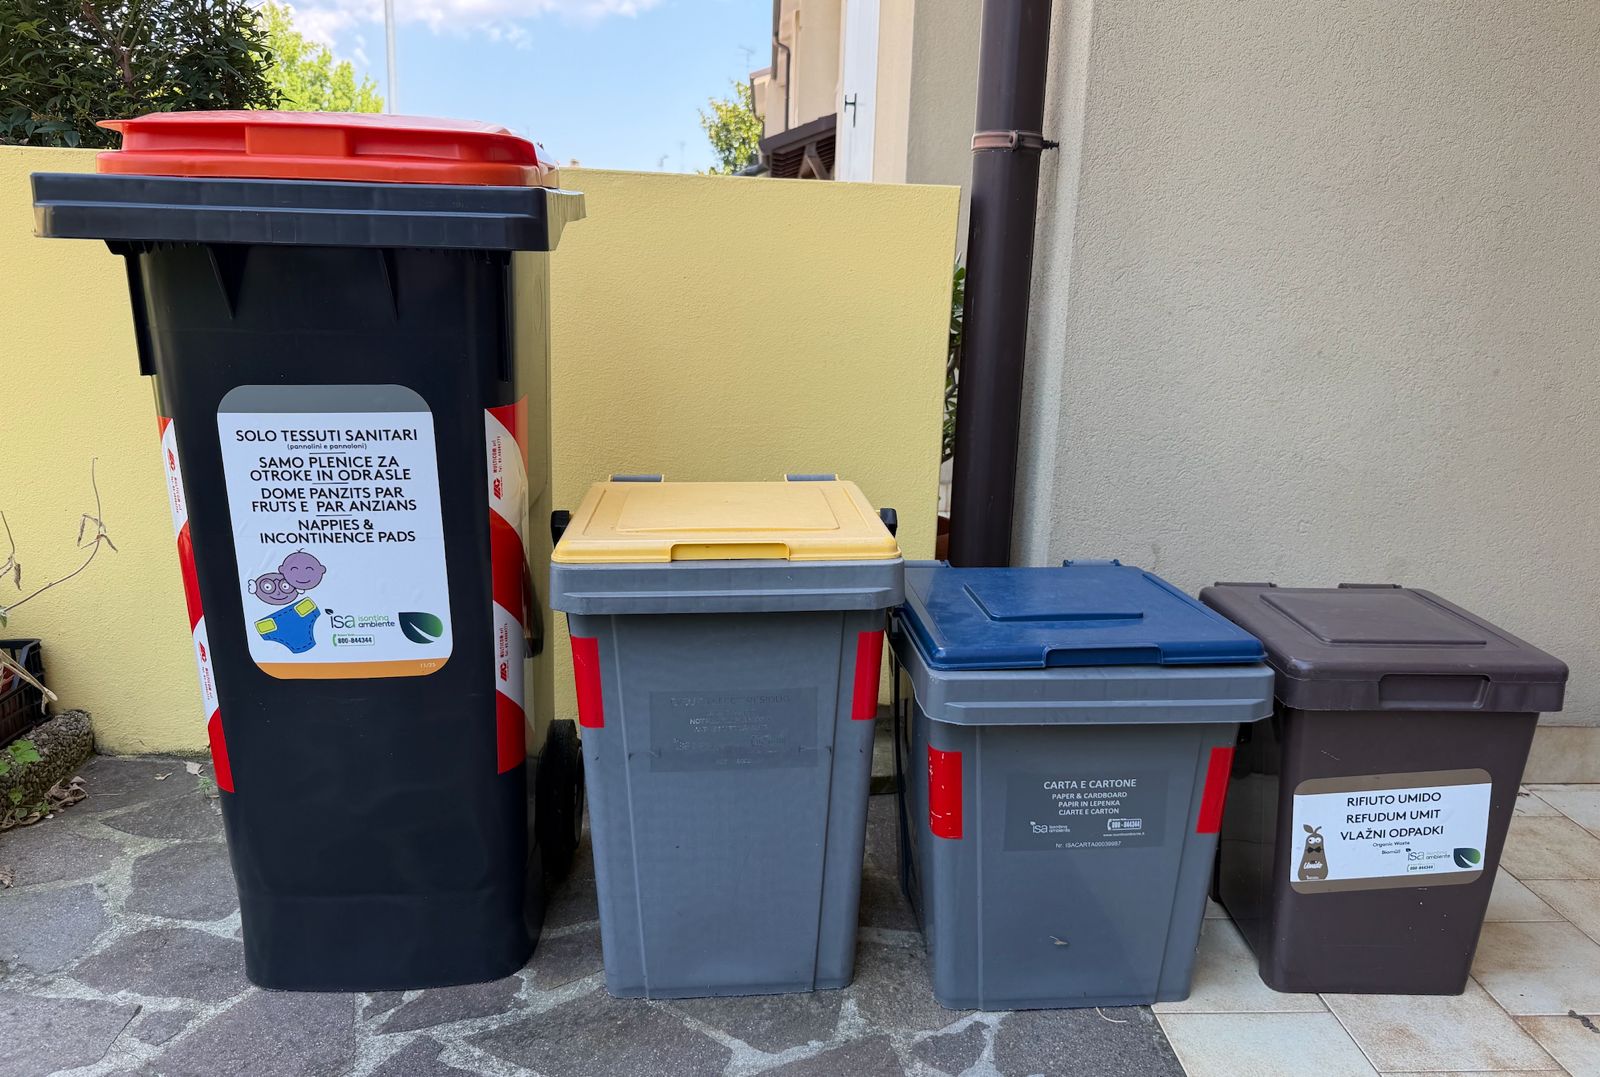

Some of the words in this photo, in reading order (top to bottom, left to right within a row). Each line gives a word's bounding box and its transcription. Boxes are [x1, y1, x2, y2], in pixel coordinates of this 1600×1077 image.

[236, 430, 277, 442] SOLO
[281, 430, 341, 442] TESSUTI
[345, 429, 417, 441] SANITARI
[259, 457, 304, 469] SAMO
[309, 456, 372, 468] PLENICE
[378, 456, 399, 468] ZA
[250, 470, 312, 482] OTROKE
[317, 469, 333, 481] IN
[339, 469, 411, 481] ODRASLE
[261, 488, 306, 500] DOME
[310, 487, 371, 499] PANZITS
[375, 487, 404, 498] PAR
[252, 501, 296, 513] FRUTS
[302, 501, 308, 512] E
[317, 501, 346, 512] PAR
[349, 500, 417, 512] ANZIANS
[298, 519, 359, 531] NAPPIES
[363, 519, 374, 530] &
[260, 532, 374, 545] INCONTINENCE
[378, 531, 416, 542] PADS
[330, 612, 355, 629] isa
[358, 620, 396, 628] ambiente
[1043, 780, 1078, 790] CARTA
[1080, 780, 1086, 789] E
[1089, 778, 1137, 788] CARTONE
[1052, 792, 1075, 800] PAPER
[1083, 791, 1128, 799] CARDBOARD
[1347, 795, 1395, 807] RIFIUTO
[1398, 792, 1442, 804] UMIDO
[1058, 800, 1079, 808] PAPIR
[1090, 799, 1121, 807] LEPENKA
[1058, 808, 1084, 816] CJARTE
[1090, 807, 1120, 815] CARTON
[1346, 812, 1406, 824] REFUDUM
[1410, 809, 1441, 820] UMIT
[1032, 821, 1048, 834] isa
[1340, 827, 1386, 841] VLAŽNI
[1389, 825, 1444, 838] ODPADKI
